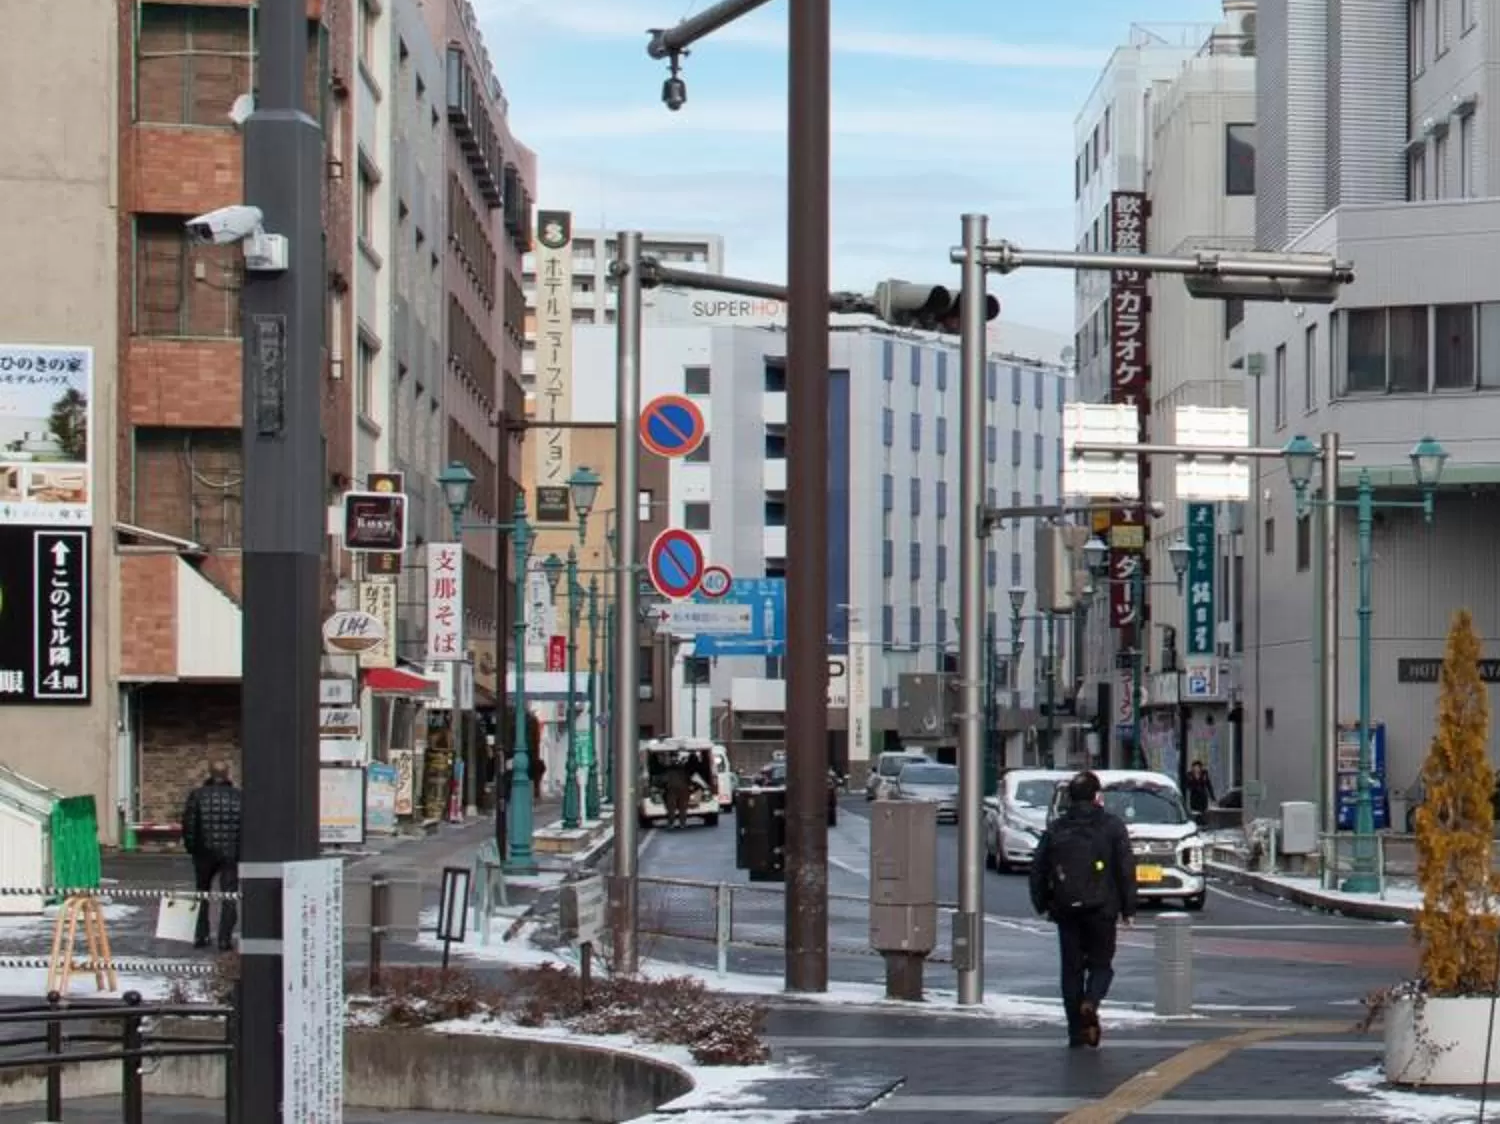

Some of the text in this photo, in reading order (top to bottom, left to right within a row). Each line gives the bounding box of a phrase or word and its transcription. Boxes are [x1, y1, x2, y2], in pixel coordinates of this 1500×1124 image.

[1115, 195, 1142, 282] 飲み放付
[1115, 290, 1143, 386] カラオケ
[432, 549, 457, 654] 支那そば
[706, 574, 725, 590] 40
[1115, 554, 1137, 625] ダーツ
